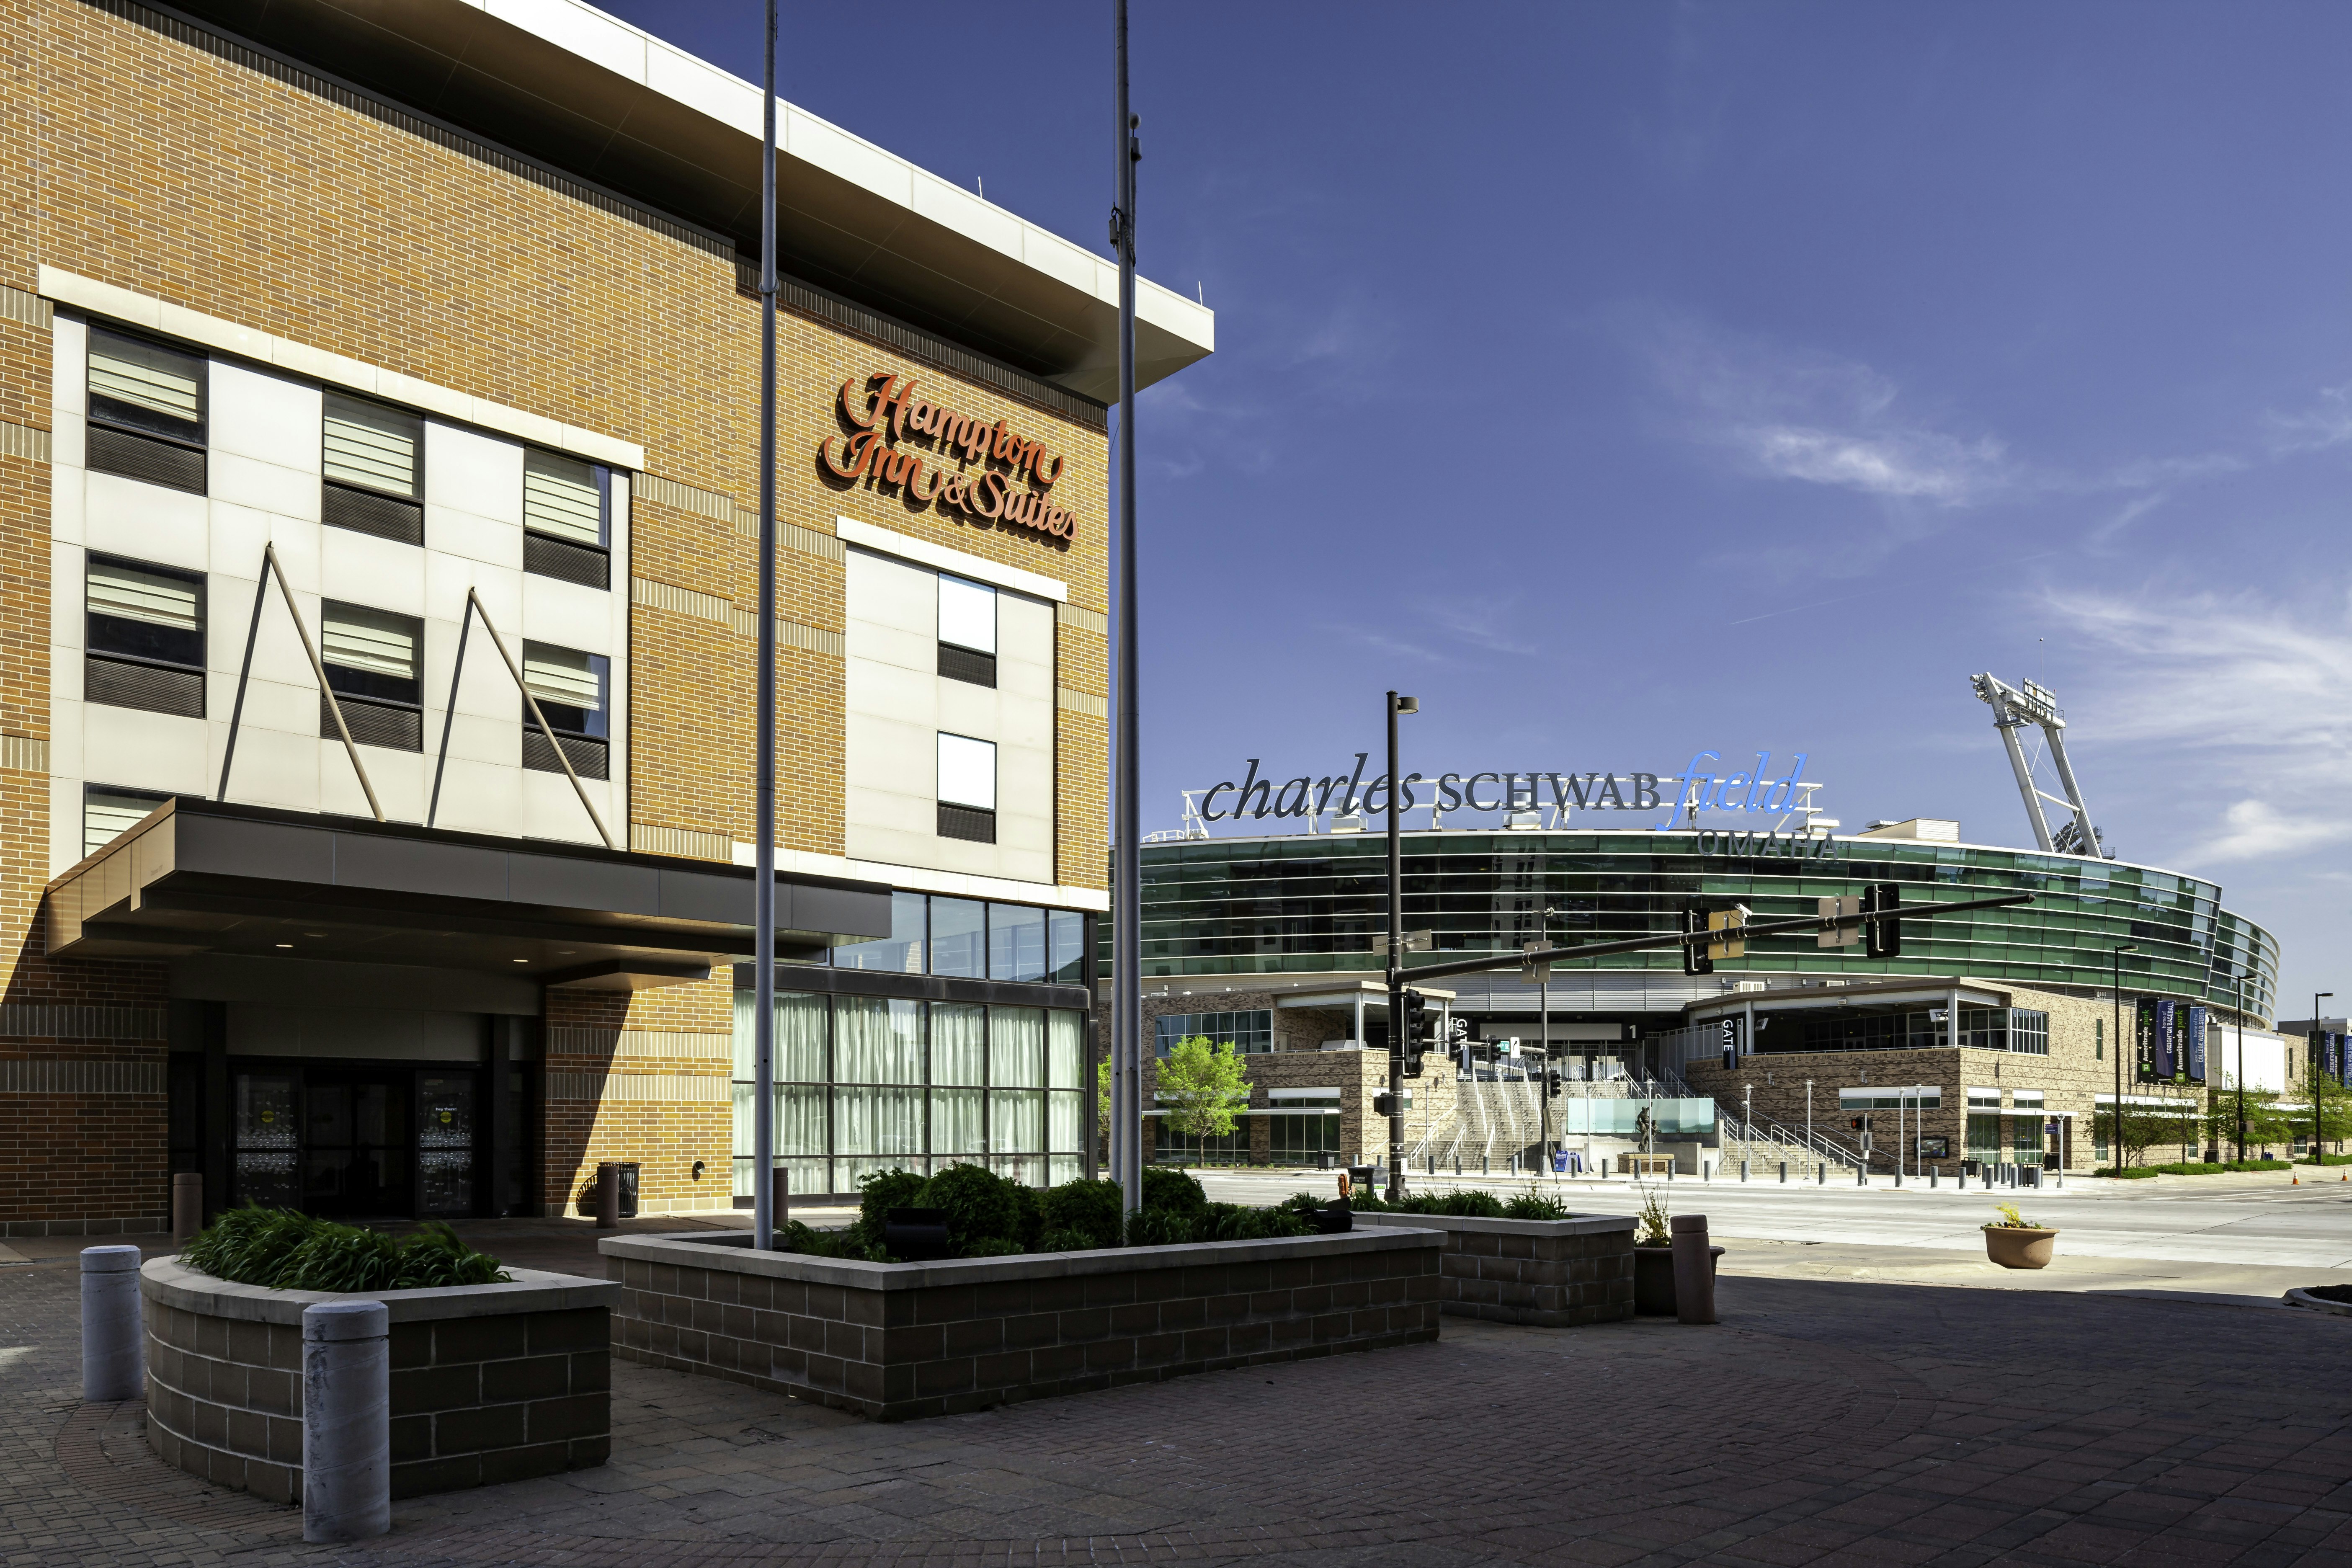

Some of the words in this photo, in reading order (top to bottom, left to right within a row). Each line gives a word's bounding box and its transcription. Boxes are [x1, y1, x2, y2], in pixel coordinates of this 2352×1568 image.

[839, 372, 1063, 484] Hampton
[823, 431, 942, 500] Inn
[944, 473, 972, 514] &
[968, 470, 1079, 541] Suites
[1201, 753, 1422, 822] charles
[1438, 772, 1661, 812] SCHWAB
[1655, 750, 1808, 832] field
[1697, 829, 1839, 859] OMAHA
[1629, 1025, 1636, 1039] 1
[2142, 1010, 2150, 1025] park
[2175, 1010, 2185, 1028] park
[1457, 1019, 1467, 1050] GATE
[1723, 1019, 1733, 1051] GATE
